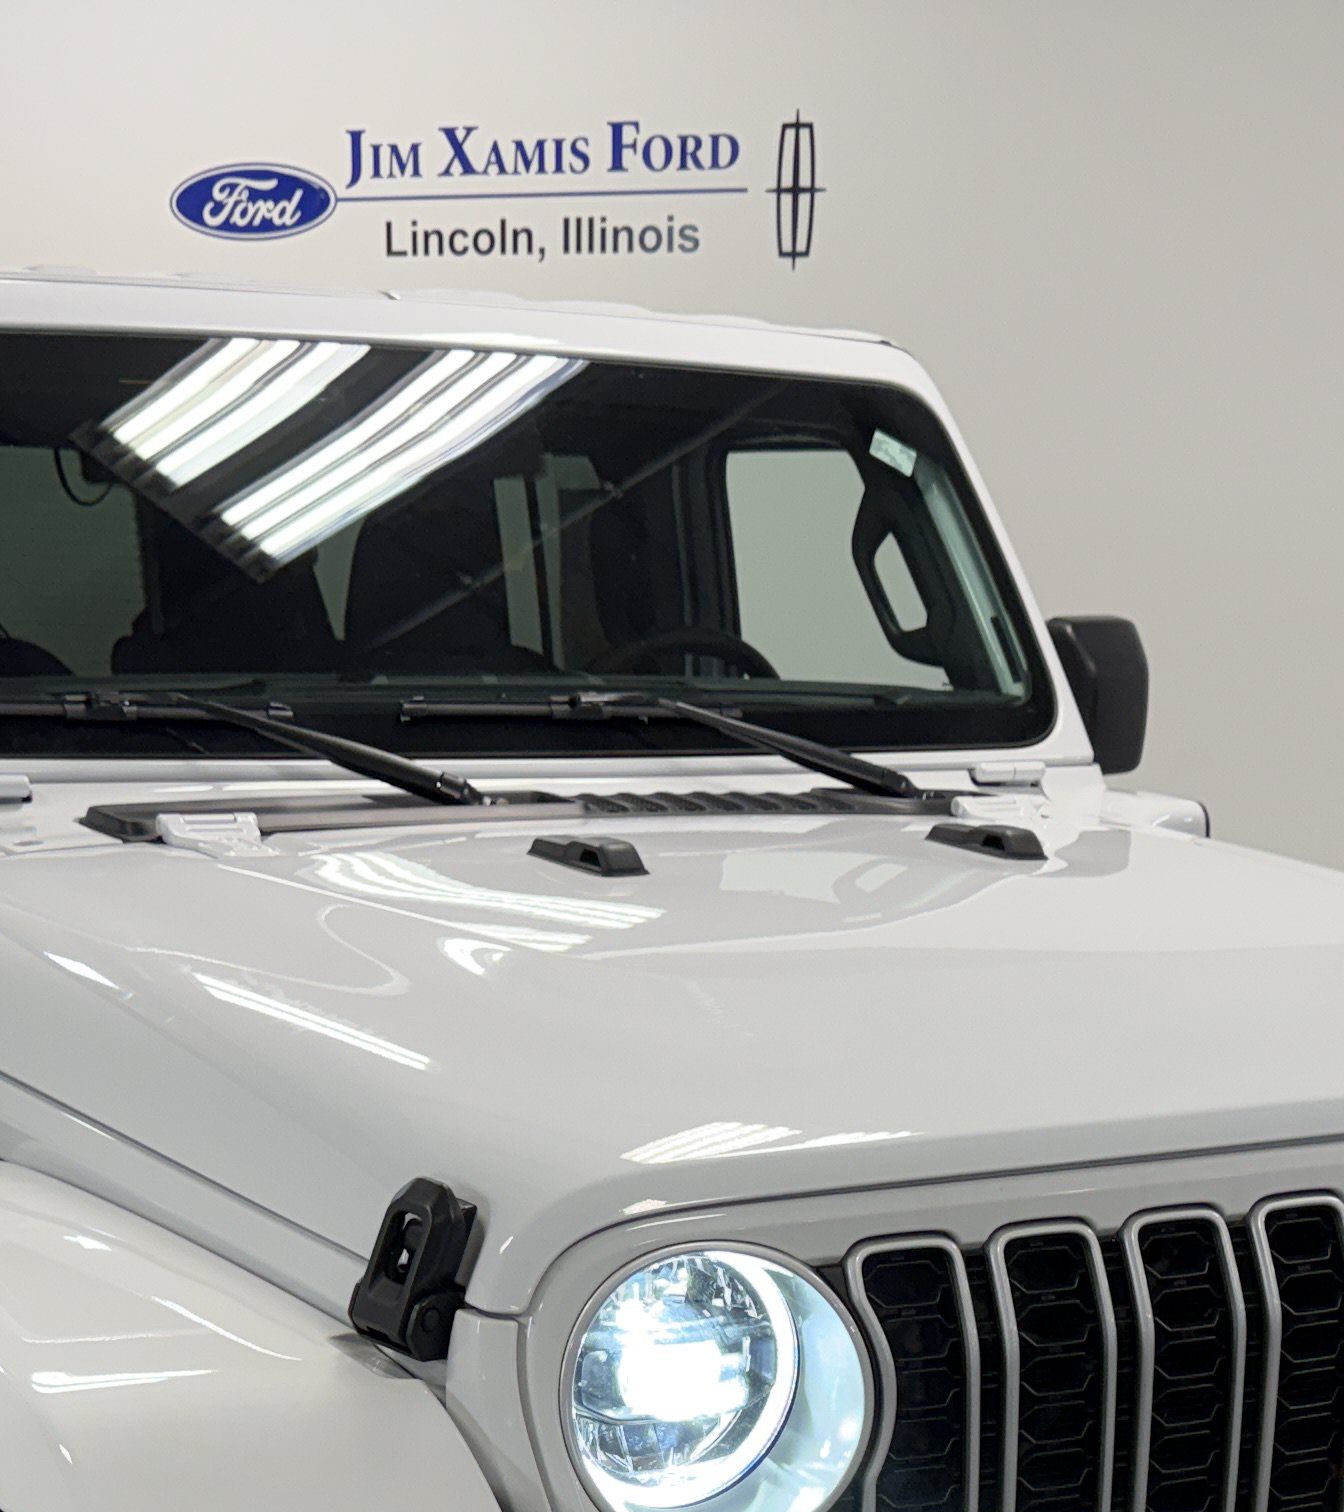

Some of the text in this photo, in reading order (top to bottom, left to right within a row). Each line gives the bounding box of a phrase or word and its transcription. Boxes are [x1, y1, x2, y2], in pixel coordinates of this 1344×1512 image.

[346, 120, 740, 189] JIM XAMIS FORD
[201, 176, 302, 229] Ford
[385, 215, 700, 262] Lincoln, Illinois
